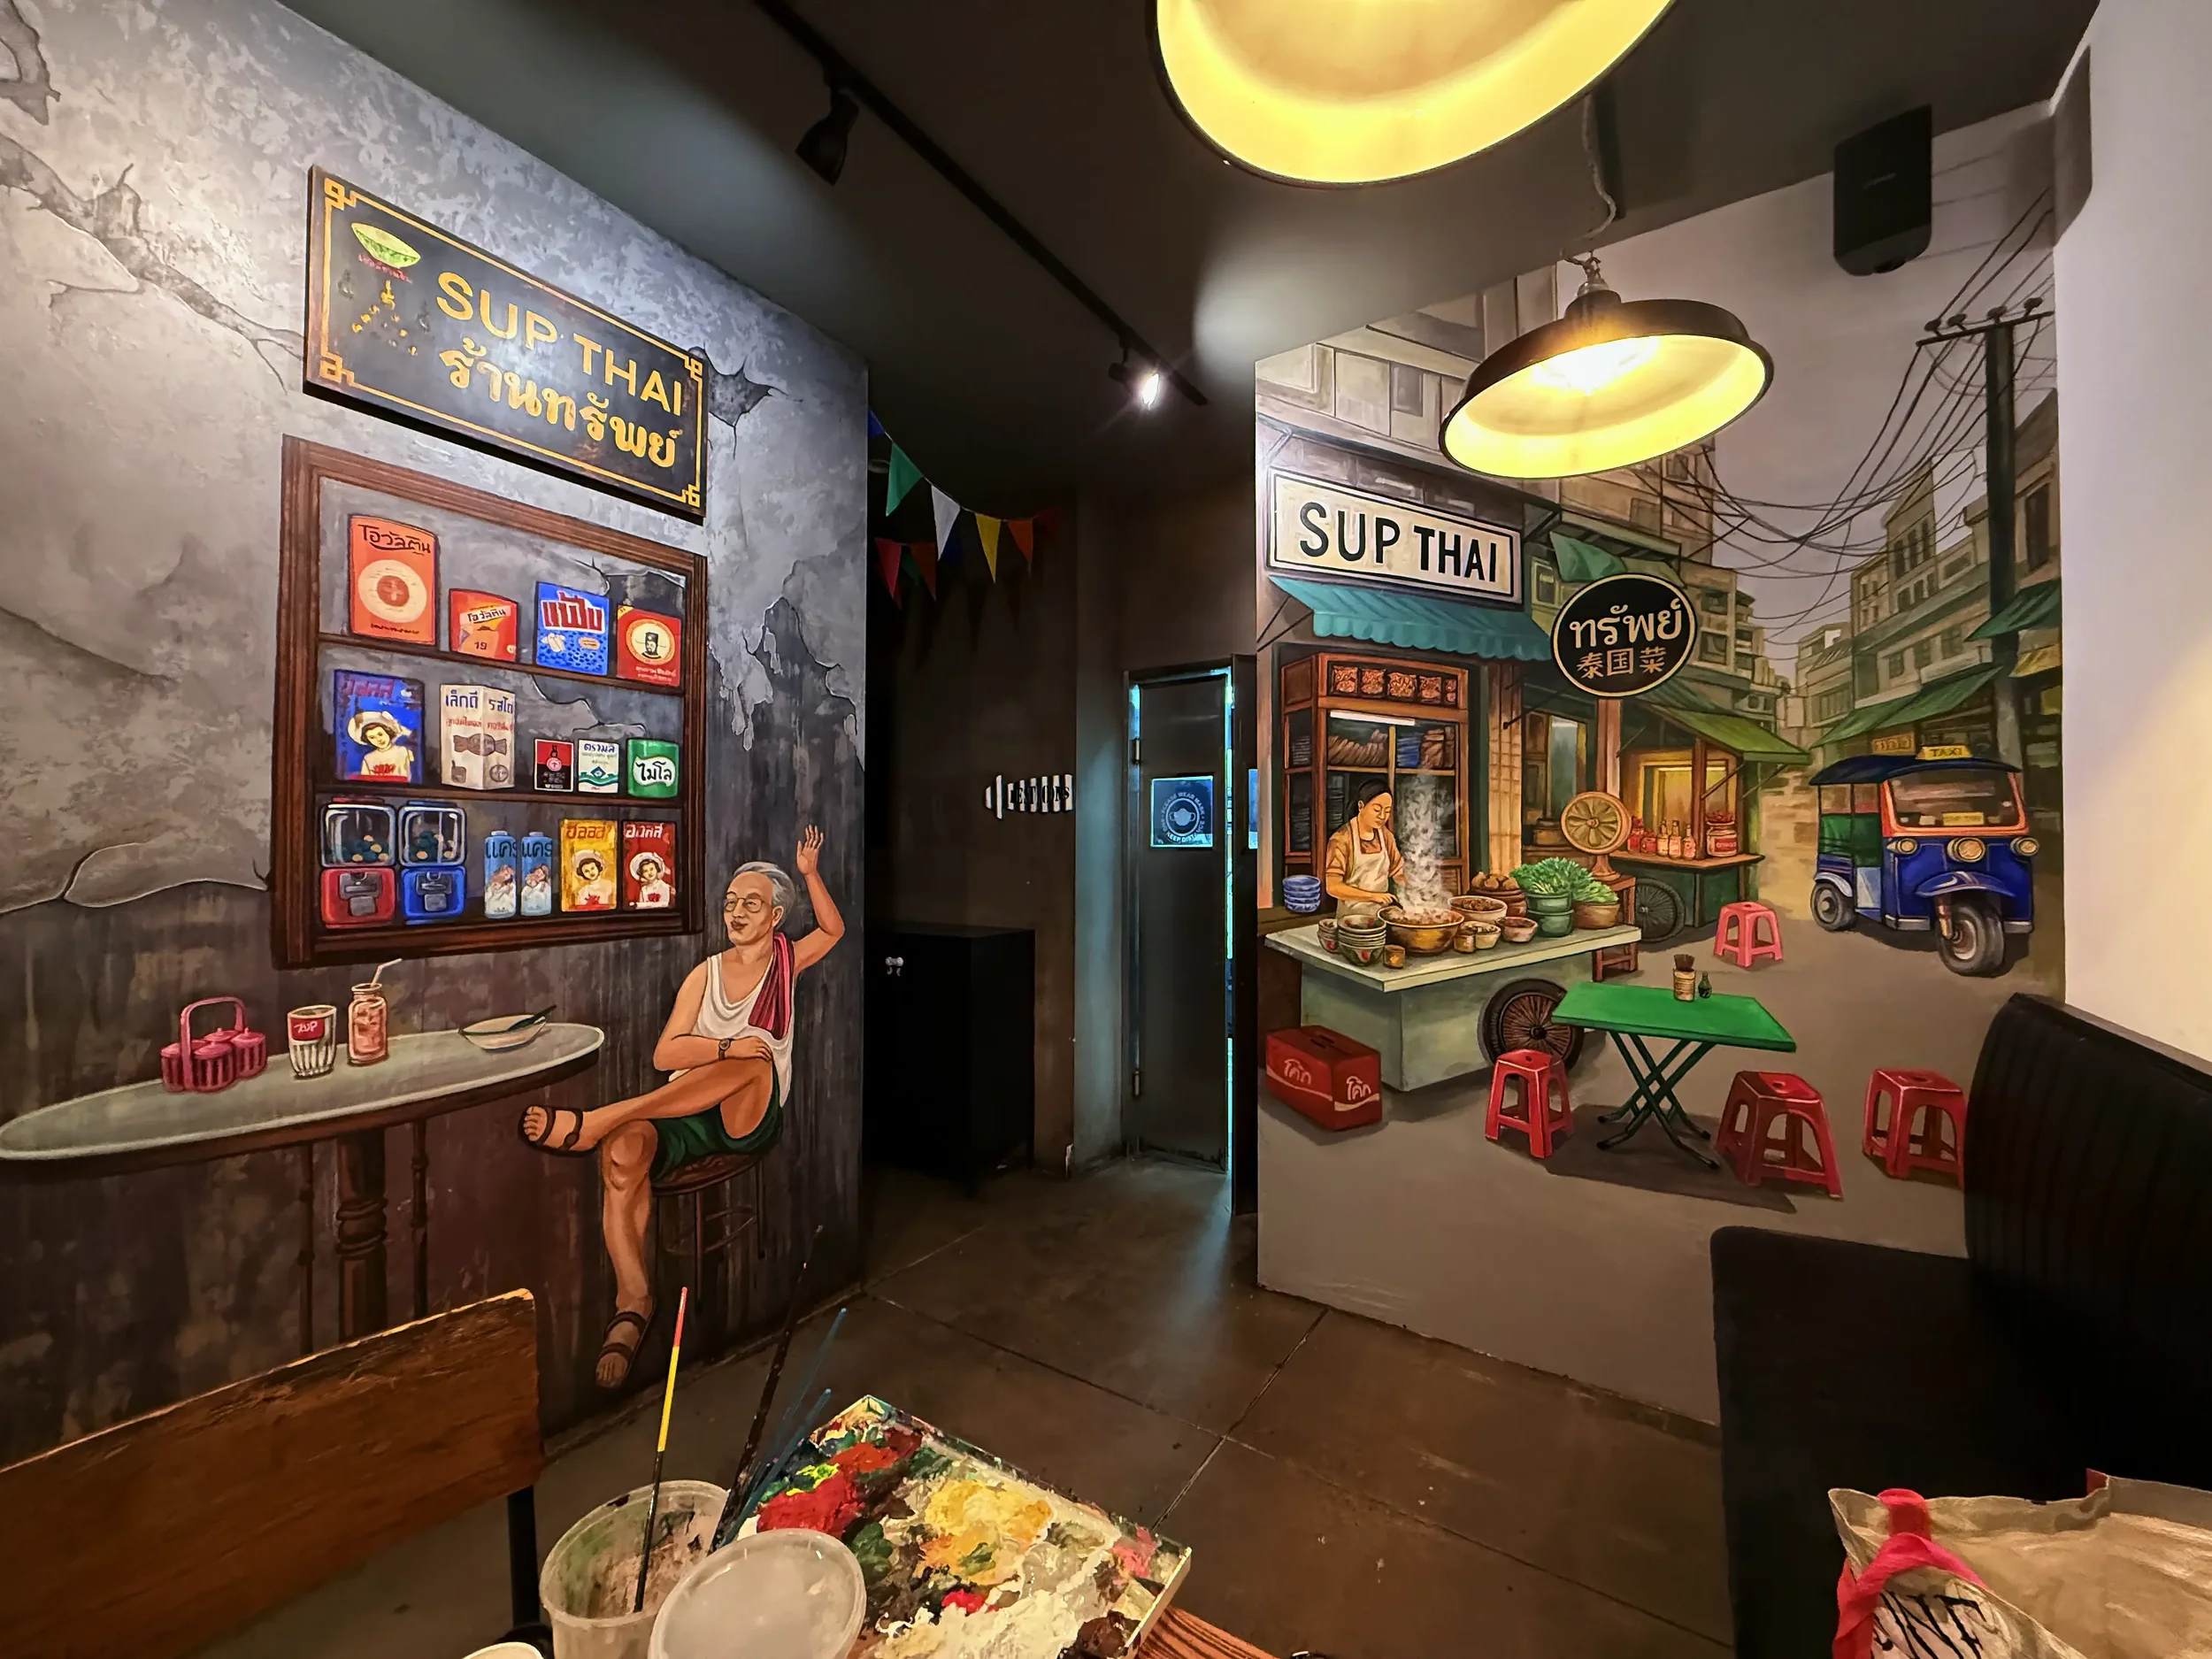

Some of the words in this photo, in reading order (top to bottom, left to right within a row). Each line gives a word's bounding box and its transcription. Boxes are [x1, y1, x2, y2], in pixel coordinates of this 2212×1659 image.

[436, 271, 557, 350] SUP
[572, 333, 681, 417] THAI
[439, 337, 683, 468] ร้านทรัพย์
[1300, 502, 1401, 565] SUP
[1413, 525, 1497, 582] THAI
[1569, 598, 1682, 649] ทรัพย์
[1576, 646, 1667, 680] 泰国菜
[1930, 748, 1962, 757] TAXI
[635, 761, 672, 781] ไมโล
[1194, 797, 1205, 815] MASK
[1167, 831, 1180, 843] KEEP
